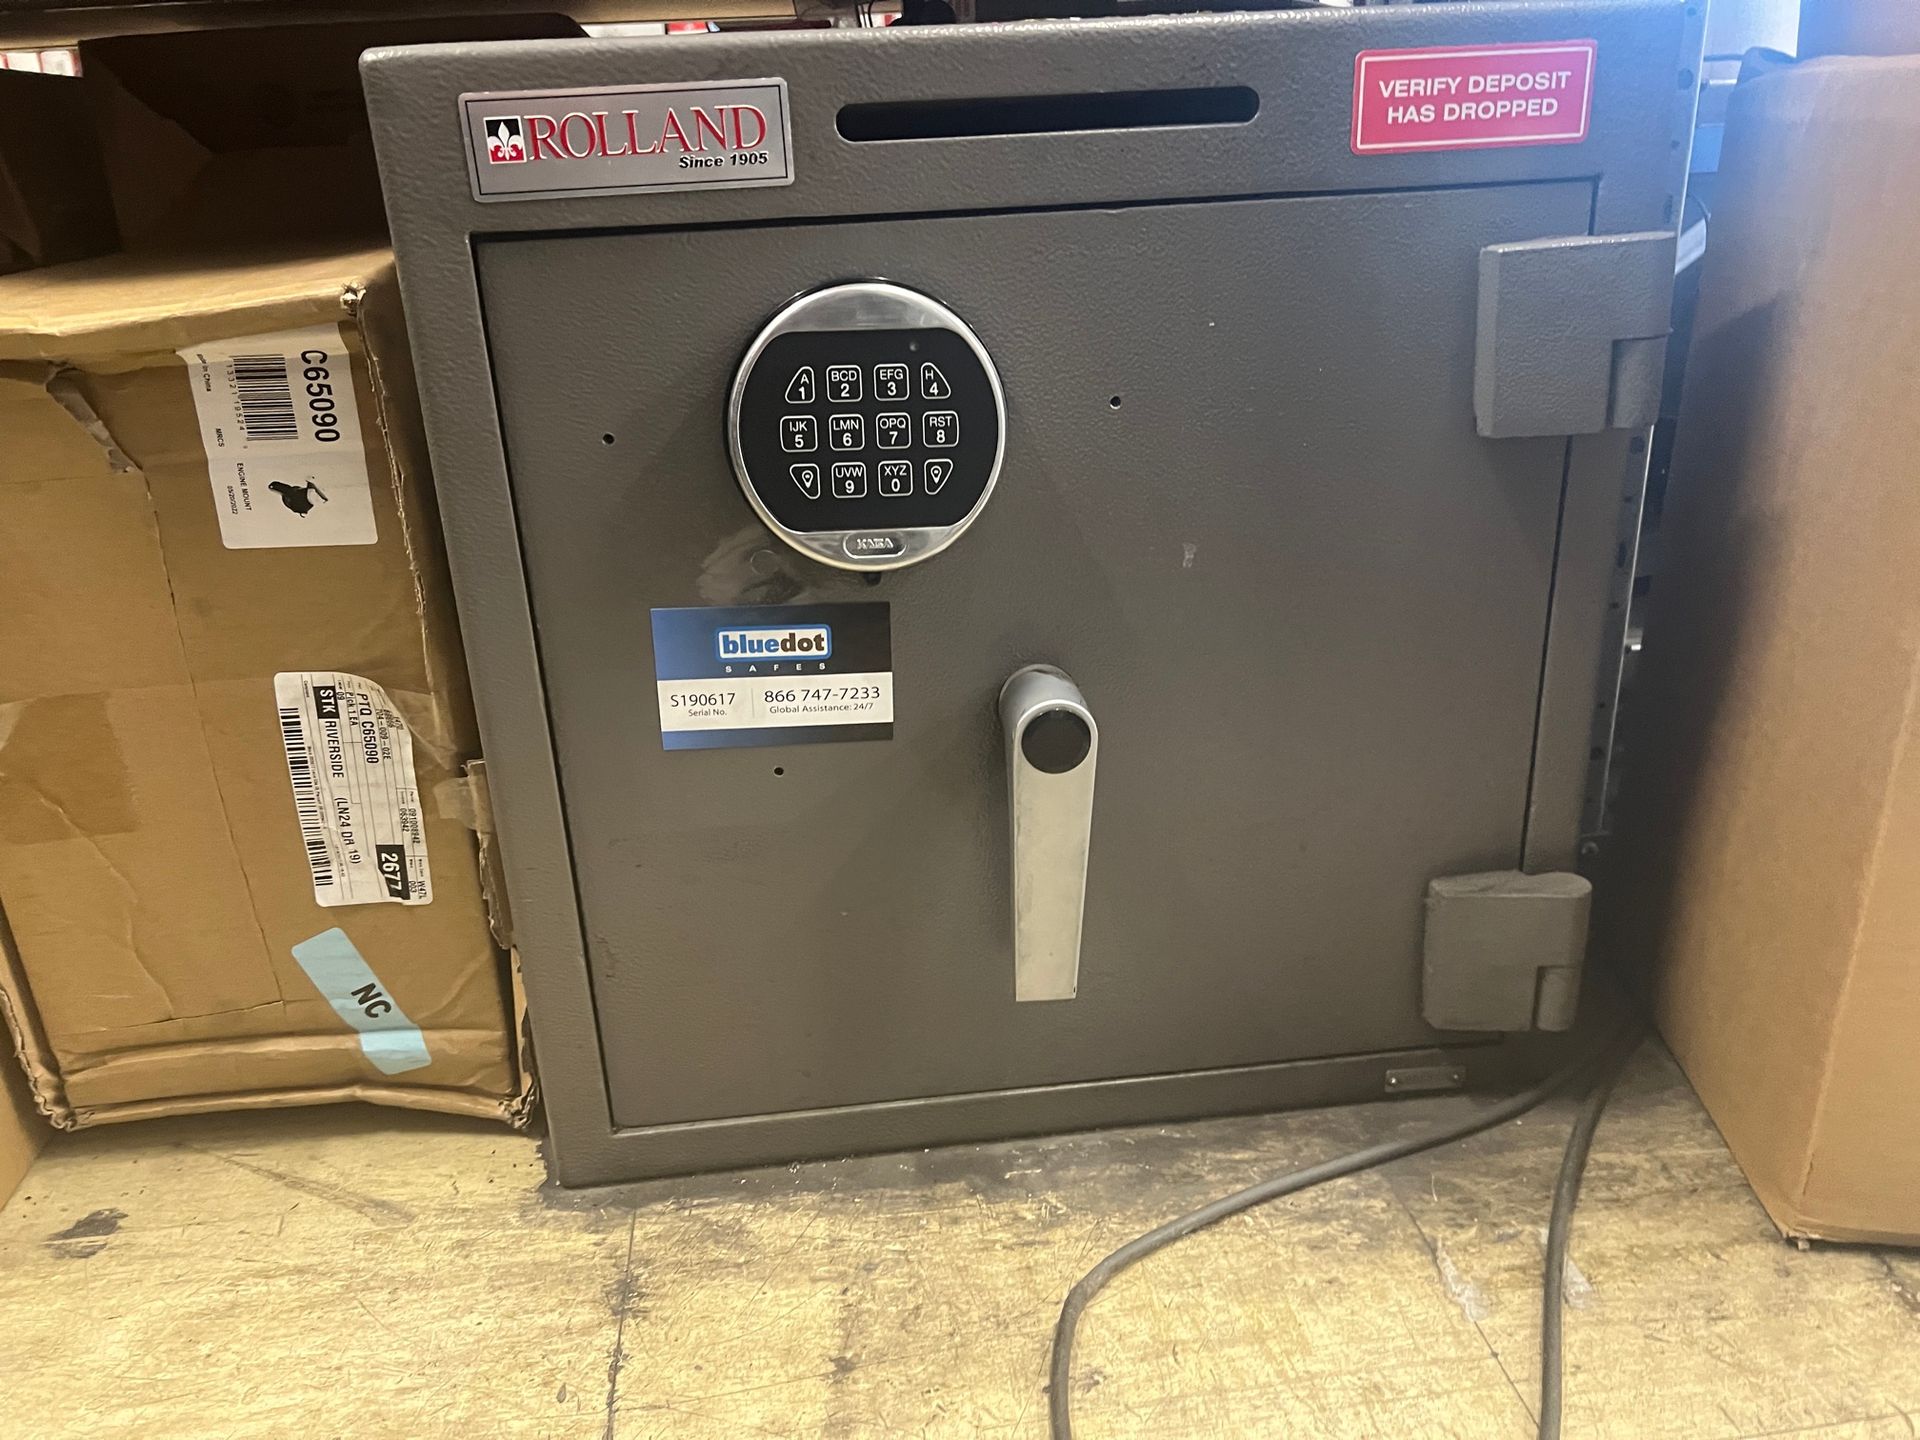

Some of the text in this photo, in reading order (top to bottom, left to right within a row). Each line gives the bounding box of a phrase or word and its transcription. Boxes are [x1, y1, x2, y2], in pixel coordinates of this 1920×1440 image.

[1378, 70, 1573, 99] VERIFY DEPOSIT
[1386, 97, 1559, 125] HAS DROPPED
[523, 104, 768, 161] ROLLAND
[678, 151, 769, 169] Since 1905
[800, 374, 810, 384] A
[831, 371, 857, 381] BCD
[879, 369, 904, 380] EFG
[925, 369, 934, 380] H
[300, 350, 340, 442] C65090
[798, 386, 806, 400] 1
[840, 383, 850, 397] 2
[887, 382, 897, 396] 3
[929, 382, 939, 396] 4
[789, 421, 808, 432] IJK
[833, 419, 859, 430] LMN
[879, 418, 906, 429] OPQ
[929, 416, 952, 427] RST
[215, 428, 225, 448] MRCS
[794, 434, 804, 448] 5
[842, 432, 852, 446] 6
[889, 431, 898, 445] 7
[936, 430, 946, 443] 8
[835, 466, 863, 478] UVW
[883, 465, 907, 476] XYZ
[236, 462, 247, 487] ENGINE
[242, 488, 252, 511] MOUNT
[845, 480, 855, 493] 9
[891, 478, 901, 492] 0
[721, 632, 826, 655] bluedot
[319, 688, 338, 714] STK
[670, 692, 736, 708] S190617
[763, 686, 881, 703] 866 747-7233
[688, 707, 728, 717] Serial No.
[769, 701, 874, 715] Global Assistance: 24/7
[350, 716, 358, 726] EA
[356, 692, 379, 764] PTQ C65090
[324, 720, 344, 778] RIVERSIDE
[333, 797, 352, 828] (LN24
[347, 849, 362, 864] 19)
[380, 853, 402, 891] 2677
[350, 982, 392, 1019] NC
